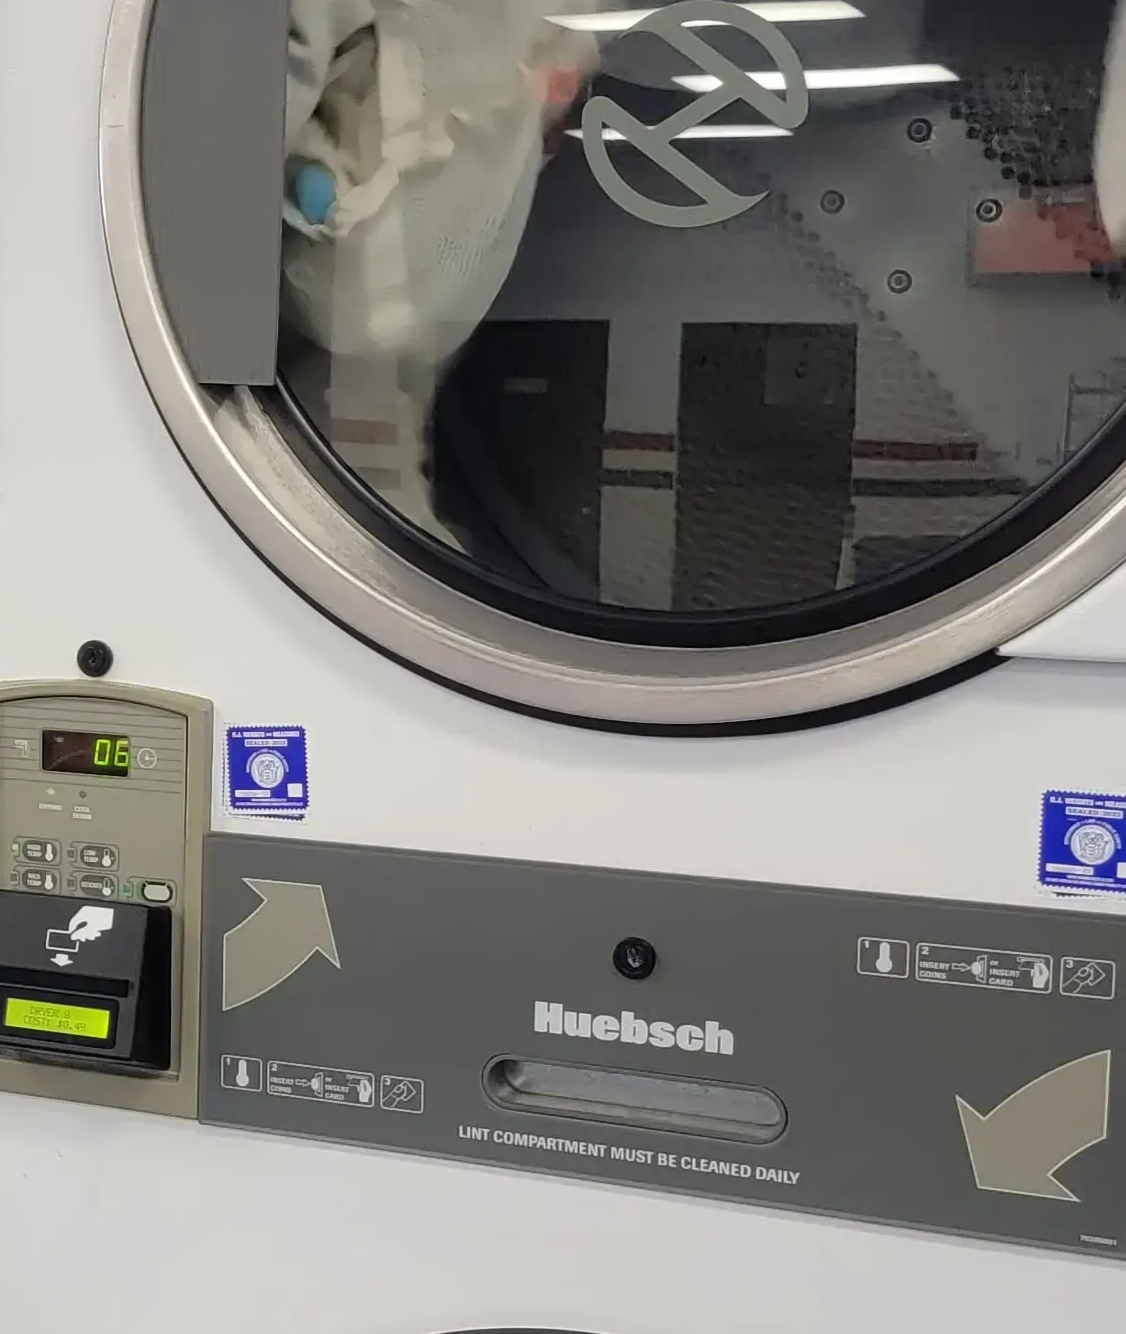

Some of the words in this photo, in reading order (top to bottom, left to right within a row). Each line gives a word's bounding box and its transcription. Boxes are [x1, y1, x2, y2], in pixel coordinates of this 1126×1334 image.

[93, 738, 130, 767] 06
[864, 941, 870, 949] 1
[921, 946, 929, 955] 2
[919, 960, 951, 971] INSERT
[1066, 959, 1074, 968] 3
[919, 970, 947, 980] COINS
[989, 968, 1021, 979] INSERT
[989, 977, 1013, 987] CARD
[29, 1006, 59, 1018] DRYER
[533, 1000, 734, 1056] Huebsch
[226, 1057, 231, 1065] 1
[271, 1064, 278, 1072] 2
[384, 1077, 391, 1086] 3
[458, 1124, 490, 1142] LINT
[492, 1129, 608, 1158] COMPARTMENT
[610, 1146, 654, 1165] MUST
[657, 1153, 677, 1168] BE
[680, 1155, 751, 1178] CLEANED
[755, 1166, 800, 1185] DAILY
